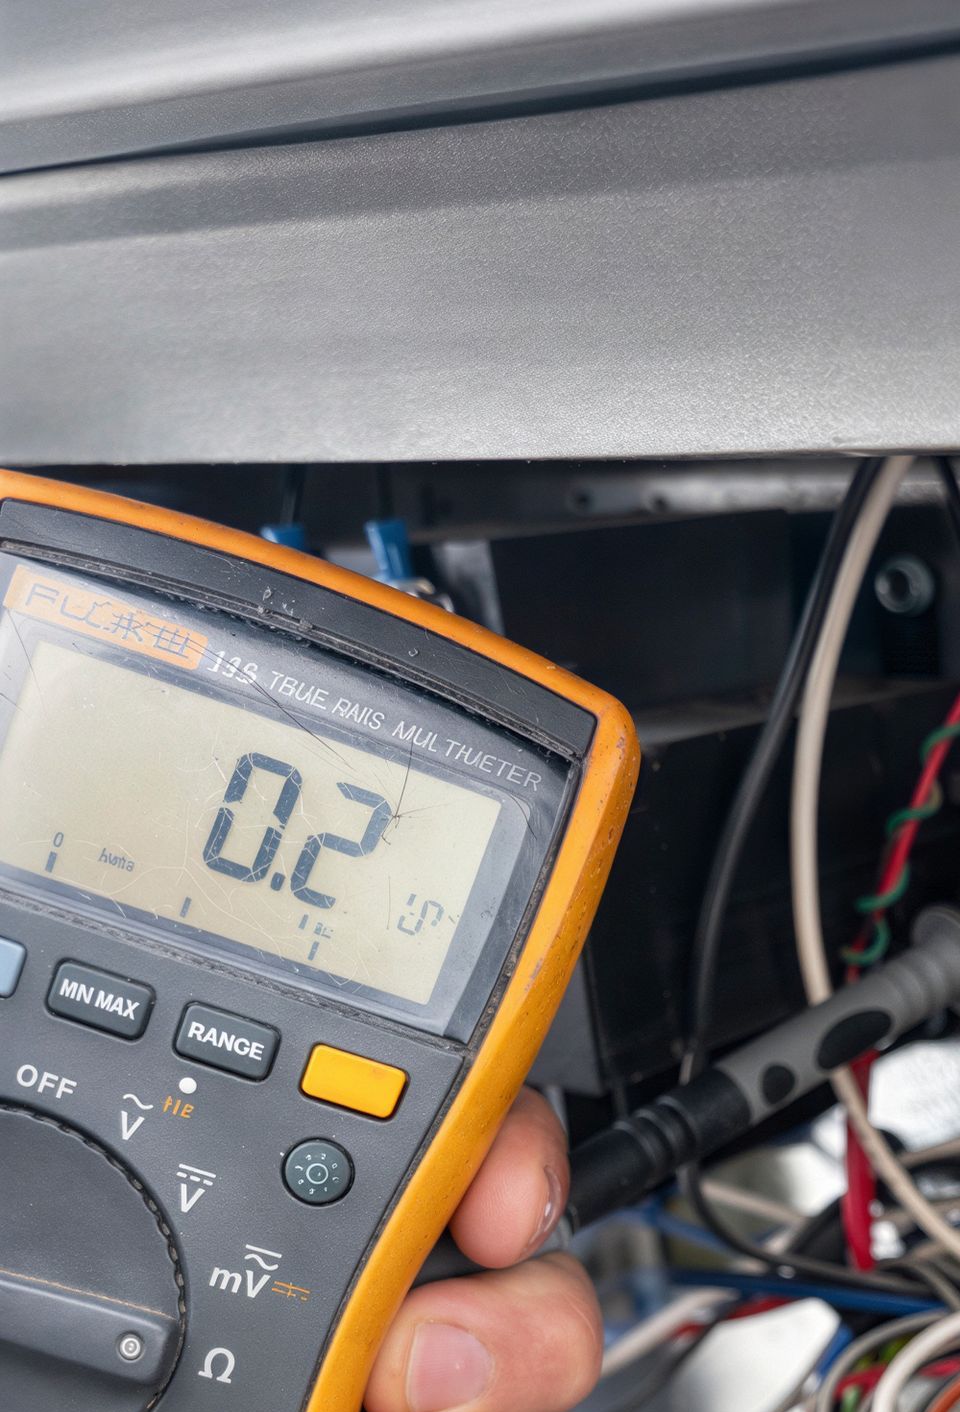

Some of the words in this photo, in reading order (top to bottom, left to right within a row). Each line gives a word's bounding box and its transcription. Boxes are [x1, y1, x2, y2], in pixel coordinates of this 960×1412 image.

[95, 990, 140, 1021] MAX
[188, 1022, 265, 1061] RANGE
[16, 1064, 77, 1099] OFF
[209, 1266, 271, 1298] mV
